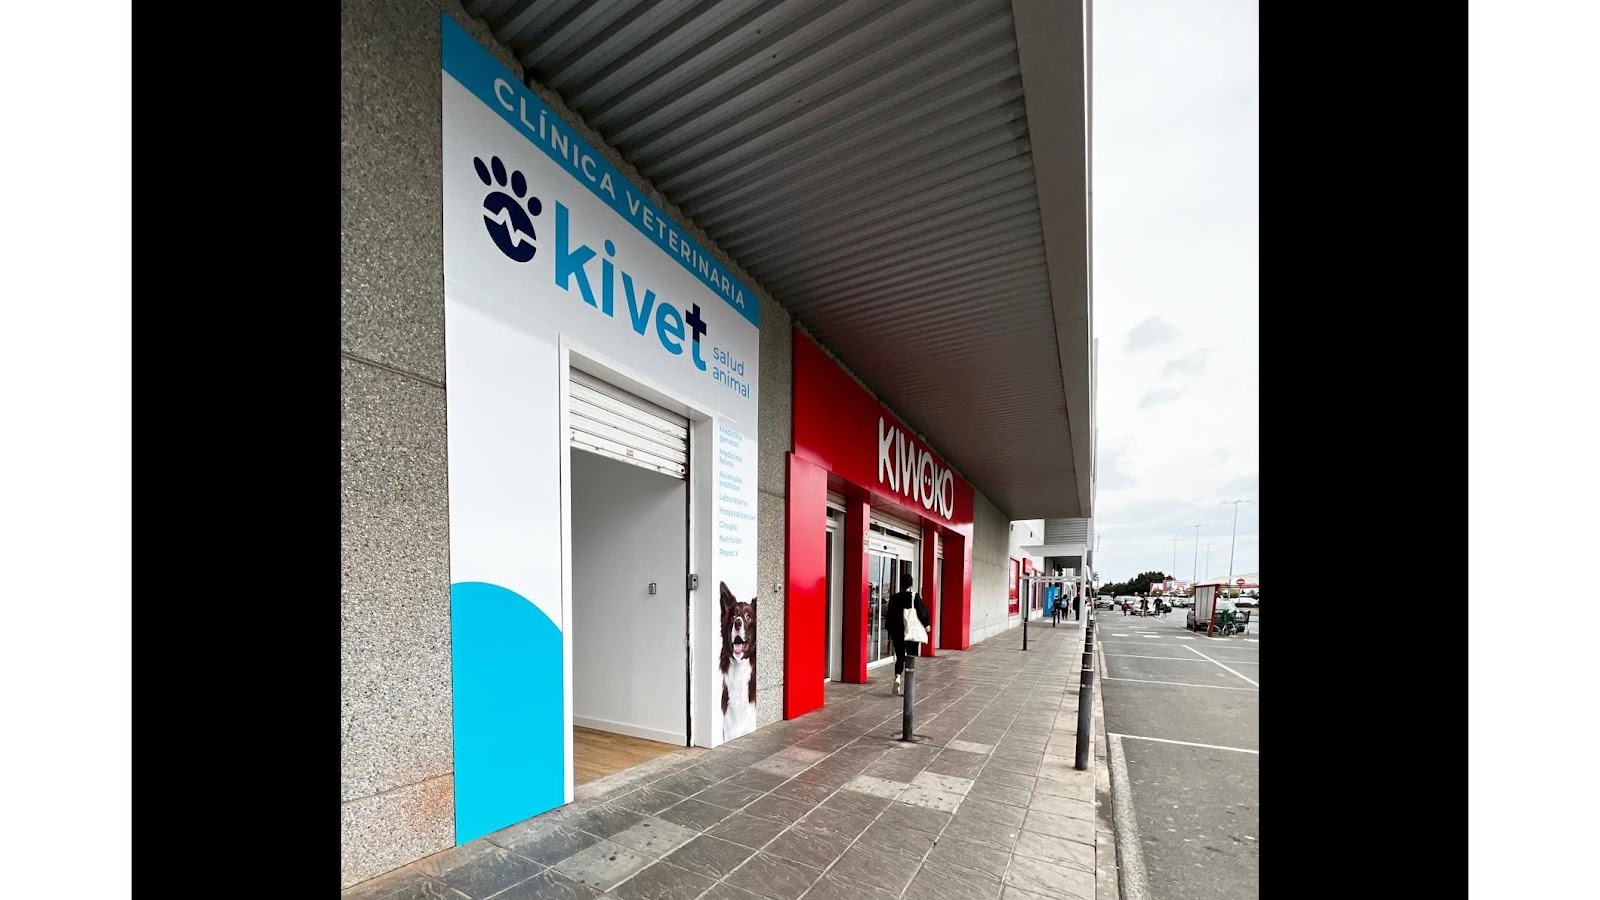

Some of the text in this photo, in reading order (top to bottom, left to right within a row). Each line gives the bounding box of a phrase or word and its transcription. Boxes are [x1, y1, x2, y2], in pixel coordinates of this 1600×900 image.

[493, 78, 745, 309] CLÍNICA VETERINARIA
[555, 200, 707, 372] kivet
[713, 346, 745, 377] salud
[712, 366, 750, 399] animal
[719, 425, 743, 441] Medicina
[719, 435, 739, 448] general
[719, 448, 743, 462] Medicina
[719, 470, 743, 484] Animales
[879, 416, 954, 520] KIWOKO
[719, 492, 748, 507] Laboratorio
